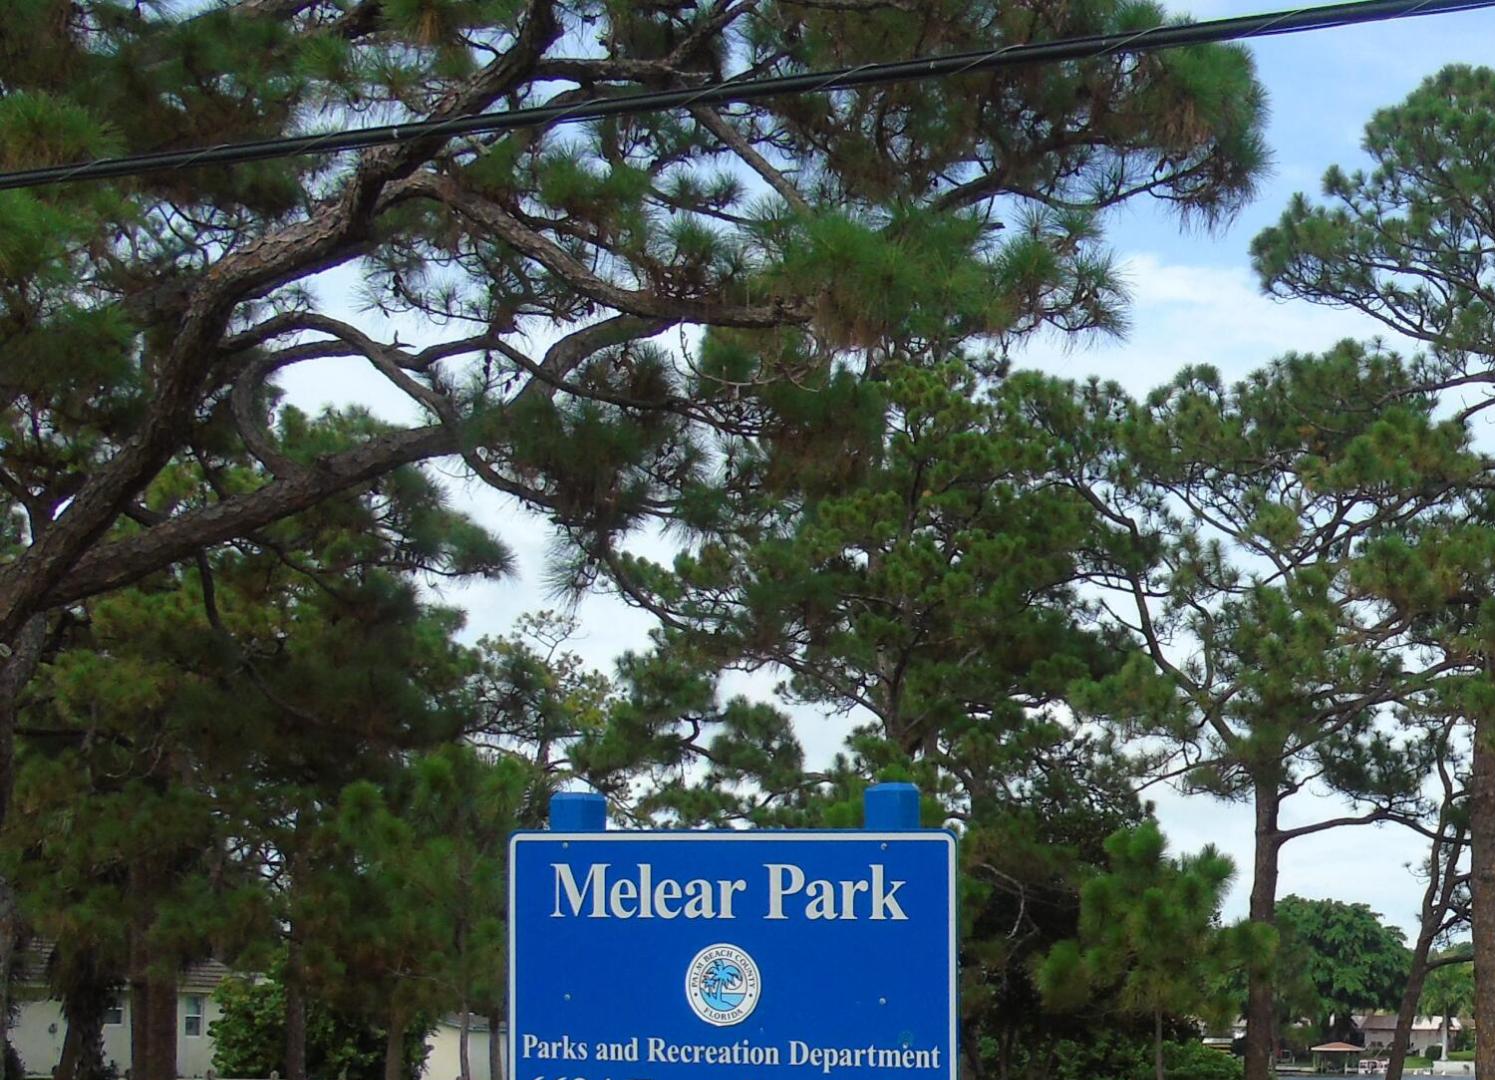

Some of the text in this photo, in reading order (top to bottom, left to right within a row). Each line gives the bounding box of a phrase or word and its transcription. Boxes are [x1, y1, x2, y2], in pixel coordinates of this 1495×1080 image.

[550, 863, 910, 921] Melear Park
[692, 950, 756, 989] PALM BEACH COUNTY
[703, 1007, 744, 1020] FLORIDA
[522, 1034, 941, 1073] Parks and Recreation Department
